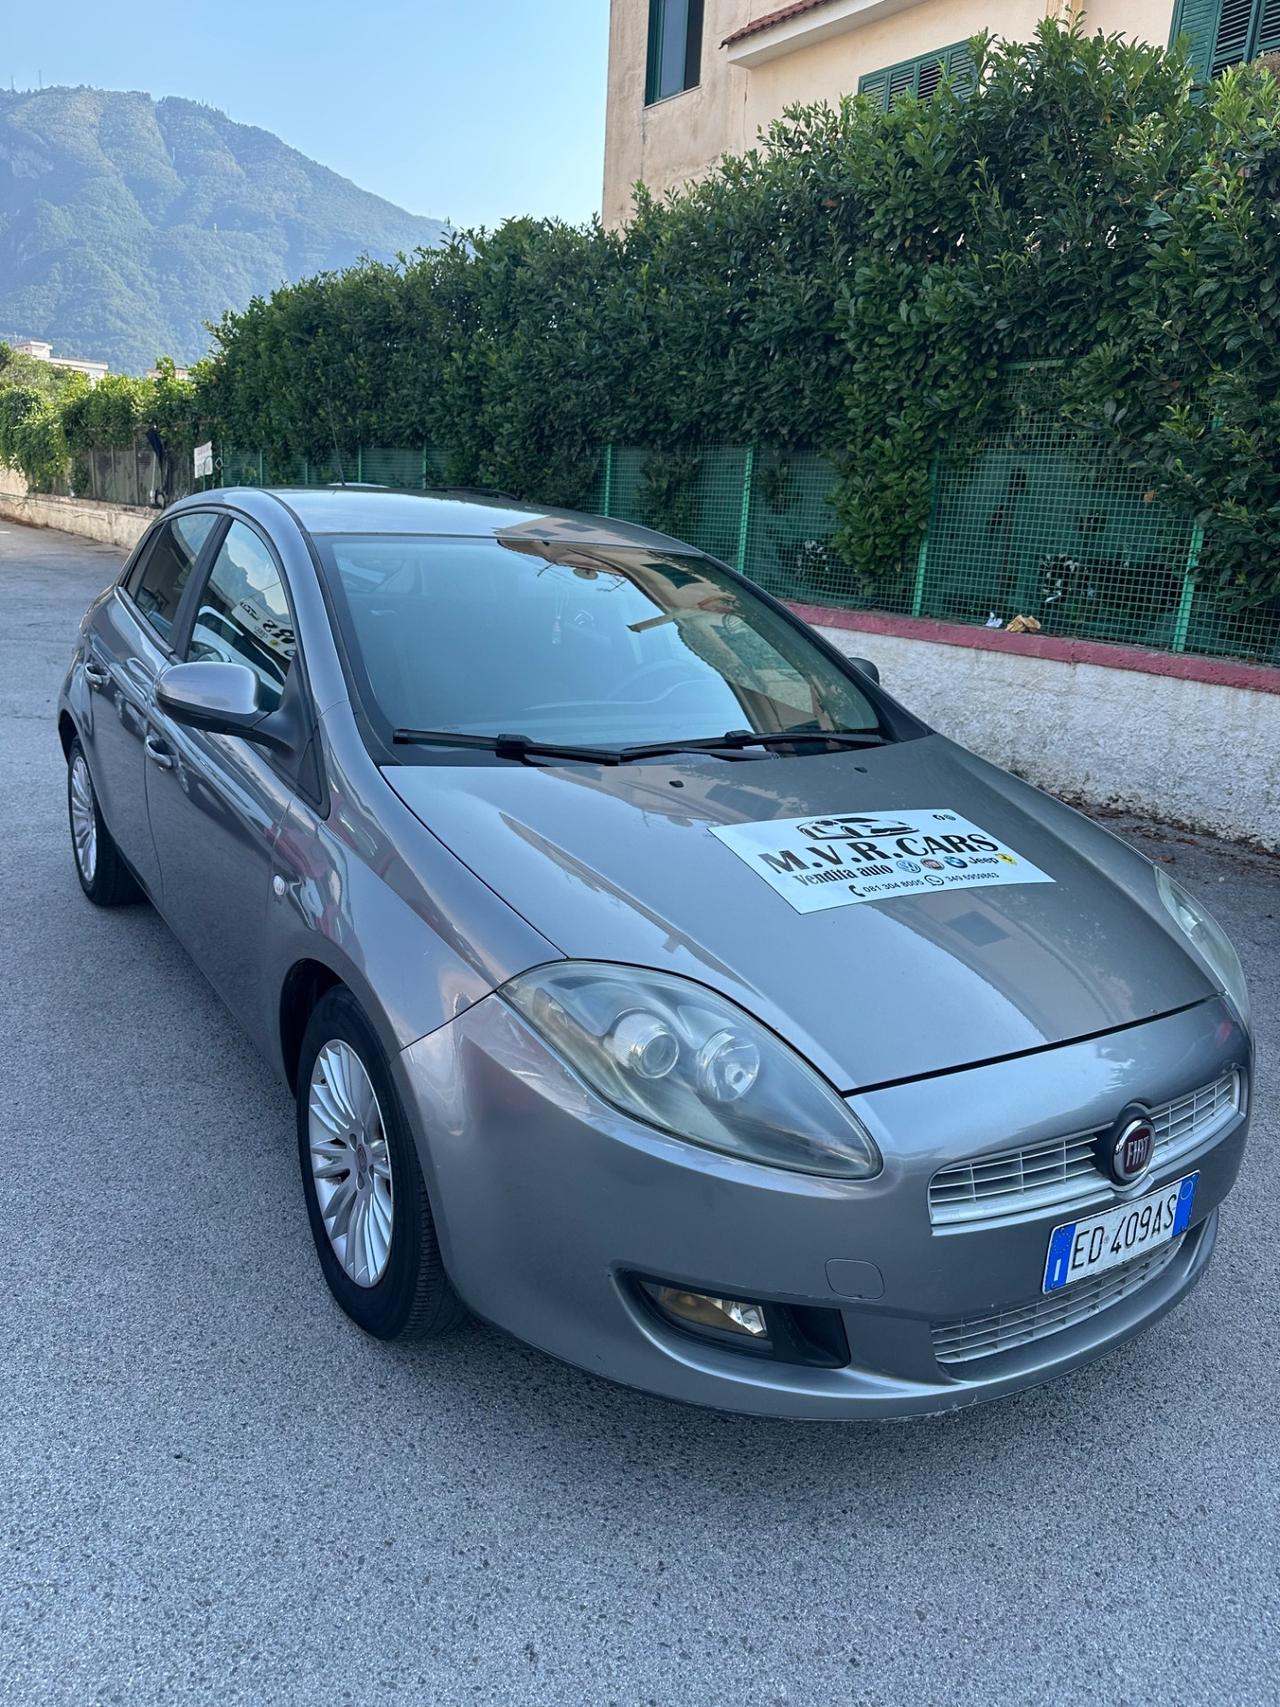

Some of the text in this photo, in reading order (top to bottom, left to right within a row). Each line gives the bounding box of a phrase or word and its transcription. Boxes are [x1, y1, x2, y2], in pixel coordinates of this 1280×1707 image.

[758, 834, 999, 874] M.V.R.CARS
[969, 856, 999, 864] Jeep
[792, 864, 893, 886] Vendita auto
[1126, 1136, 1150, 1167] FIAT
[1071, 1226, 1104, 1270] ED
